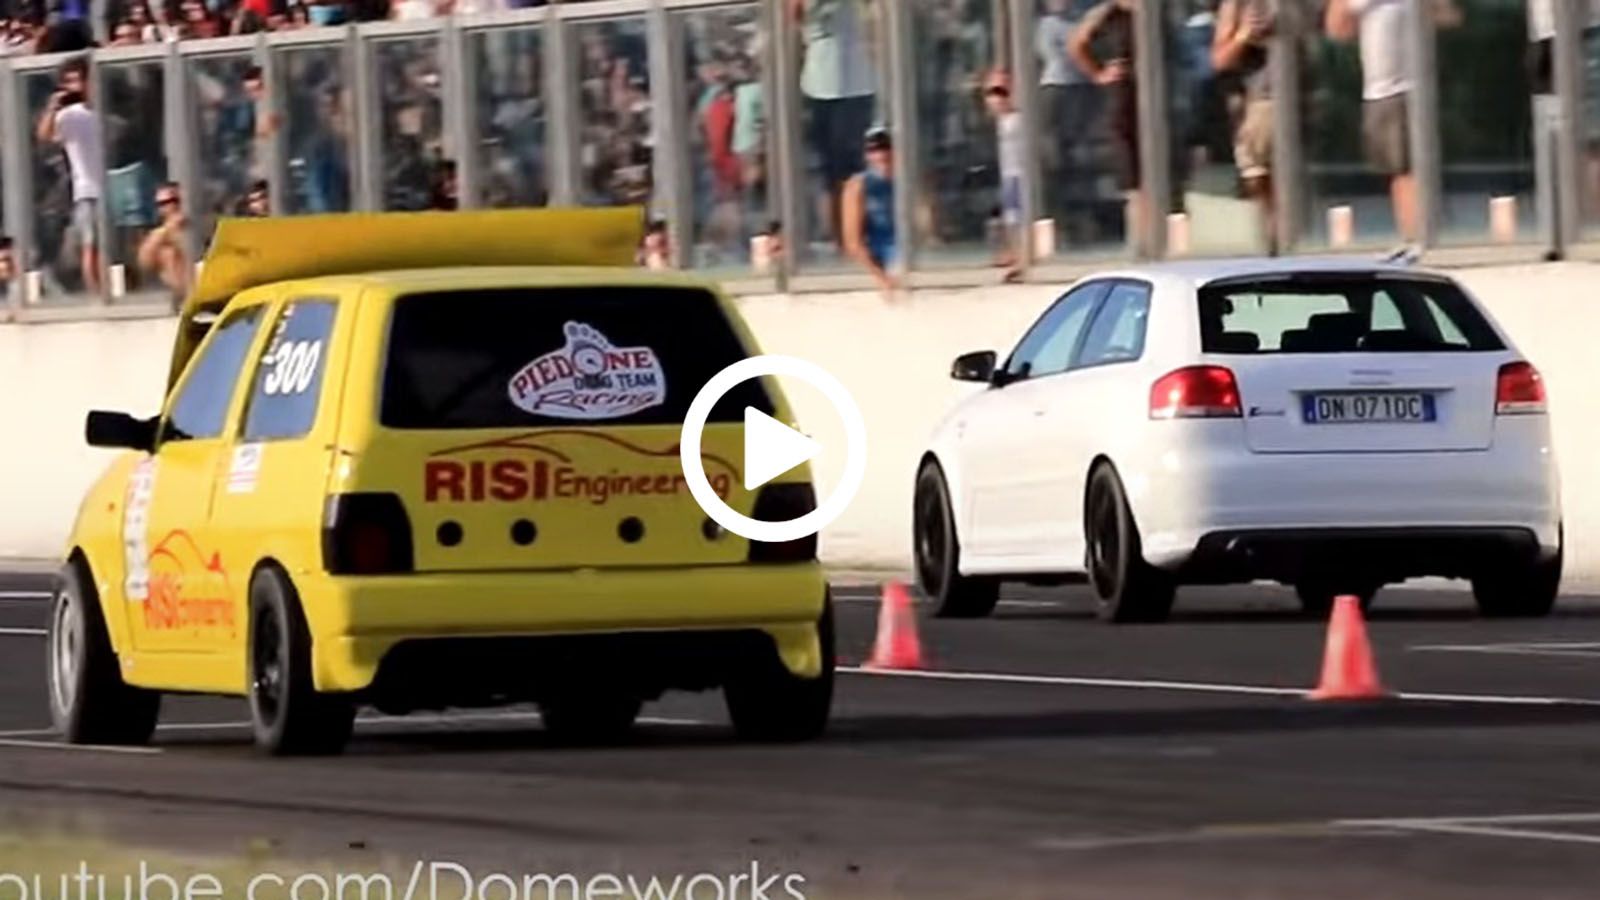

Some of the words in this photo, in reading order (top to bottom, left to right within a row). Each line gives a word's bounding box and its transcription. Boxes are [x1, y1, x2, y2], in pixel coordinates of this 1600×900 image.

[264, 340, 321, 395] 300
[513, 344, 653, 398] PIEDONE
[615, 373, 657, 390] TEAM
[425, 460, 548, 501] RISI
[554, 467, 730, 504] Engineerg
